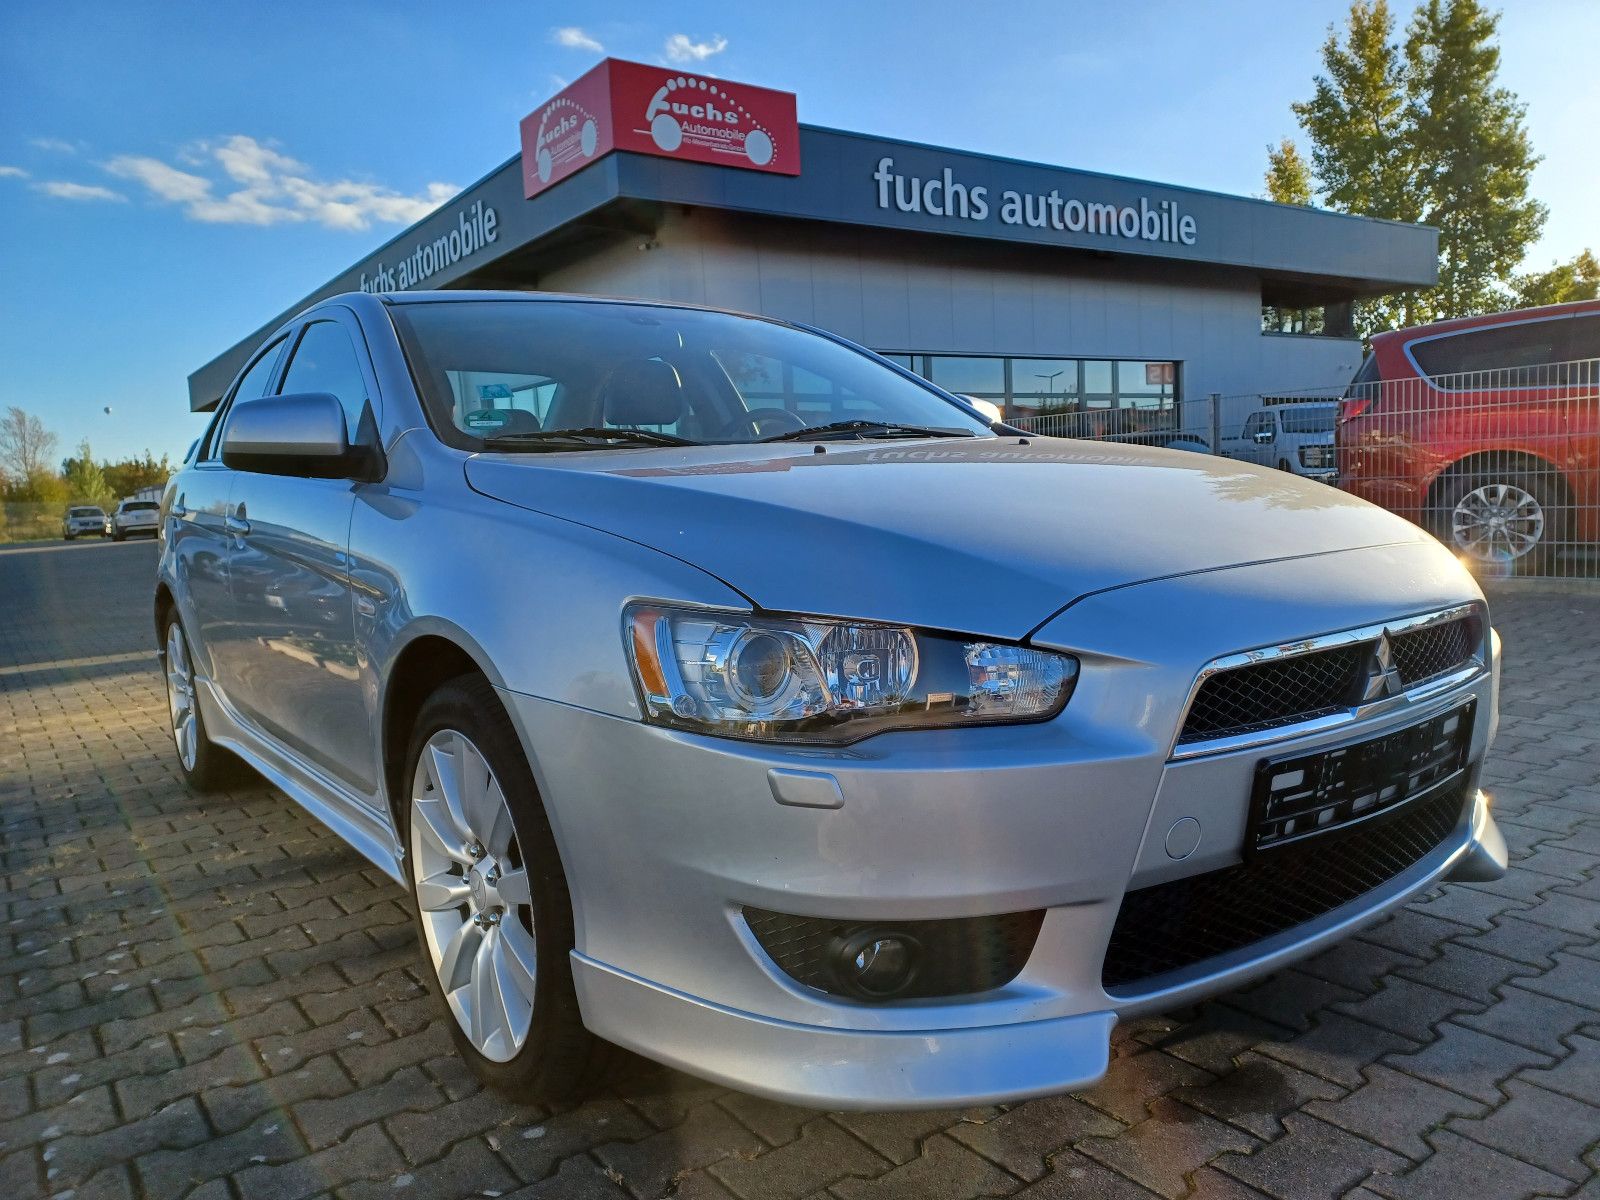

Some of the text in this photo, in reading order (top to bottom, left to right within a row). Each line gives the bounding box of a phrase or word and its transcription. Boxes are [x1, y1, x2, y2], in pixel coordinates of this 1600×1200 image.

[681, 120, 746, 141] Automobile
[398, 199, 497, 290] automobile
[873, 157, 1198, 246] fuchs automobile
